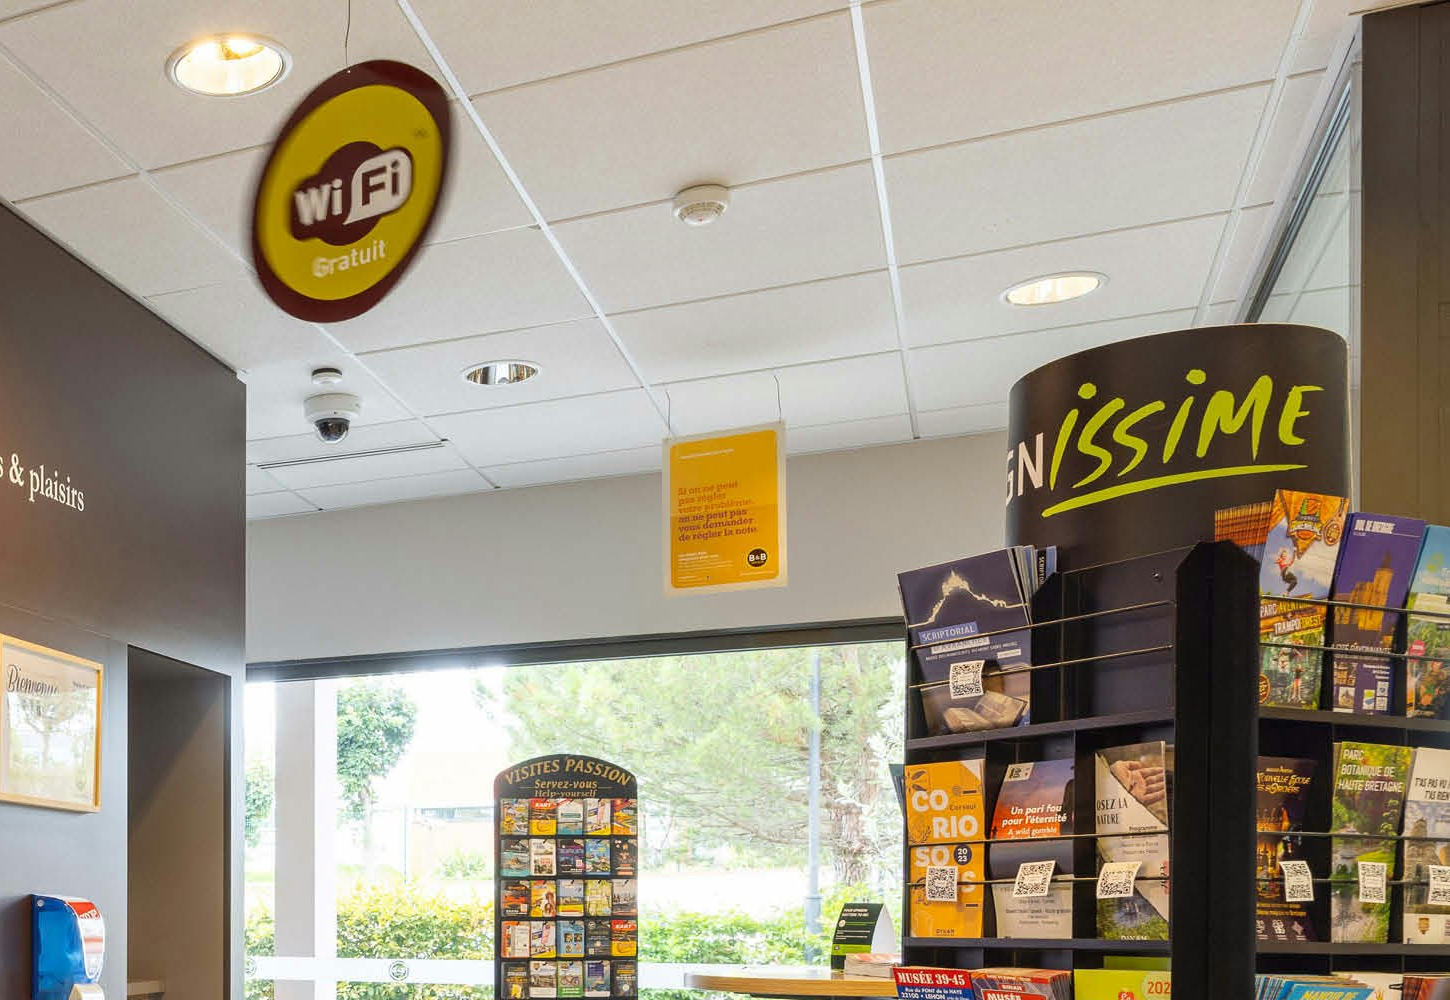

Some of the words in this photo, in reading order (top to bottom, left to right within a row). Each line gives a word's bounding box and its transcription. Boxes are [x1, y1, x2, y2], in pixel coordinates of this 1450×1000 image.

[312, 239, 386, 279] Gratuit
[8, 453, 25, 487] &
[28, 464, 86, 512] plaisirs
[706, 510, 728, 524] peut
[729, 508, 748, 519] pas
[678, 524, 701, 533] vous
[702, 517, 754, 530] demander
[678, 533, 691, 542] de
[692, 528, 723, 541] régler
[1260, 603, 1277, 618] PARC
[922, 625, 976, 642] SCRIPTORIAL
[1343, 749, 1365, 760] PARC
[505, 759, 560, 785] VISITES
[565, 759, 632, 786] PASSION
[1341, 764, 1383, 777] BOTANIQUE
[1383, 766, 1396, 777] DE
[534, 779, 598, 789] Servez-vous
[1338, 780, 1364, 791] HAUTE
[1364, 780, 1404, 793] BRETAGNE
[534, 789, 598, 798] Help-yourself
[911, 789, 948, 812] CO
[1118, 797, 1128, 809] LA
[1011, 806, 1023, 815] Un
[1025, 805, 1044, 817] pari
[1046, 804, 1062, 813] fou
[932, 814, 978, 839] RIO
[1002, 819, 1022, 828] pour
[1025, 813, 1067, 825] l'éternité
[1129, 825, 1158, 833] Programme
[914, 845, 950, 868] SO
[957, 847, 968, 855] 20
[957, 854, 968, 863] 23
[897, 971, 934, 984] MUSÉE
[935, 973, 965, 986] 39-45
[1147, 981, 1171, 995] 202
